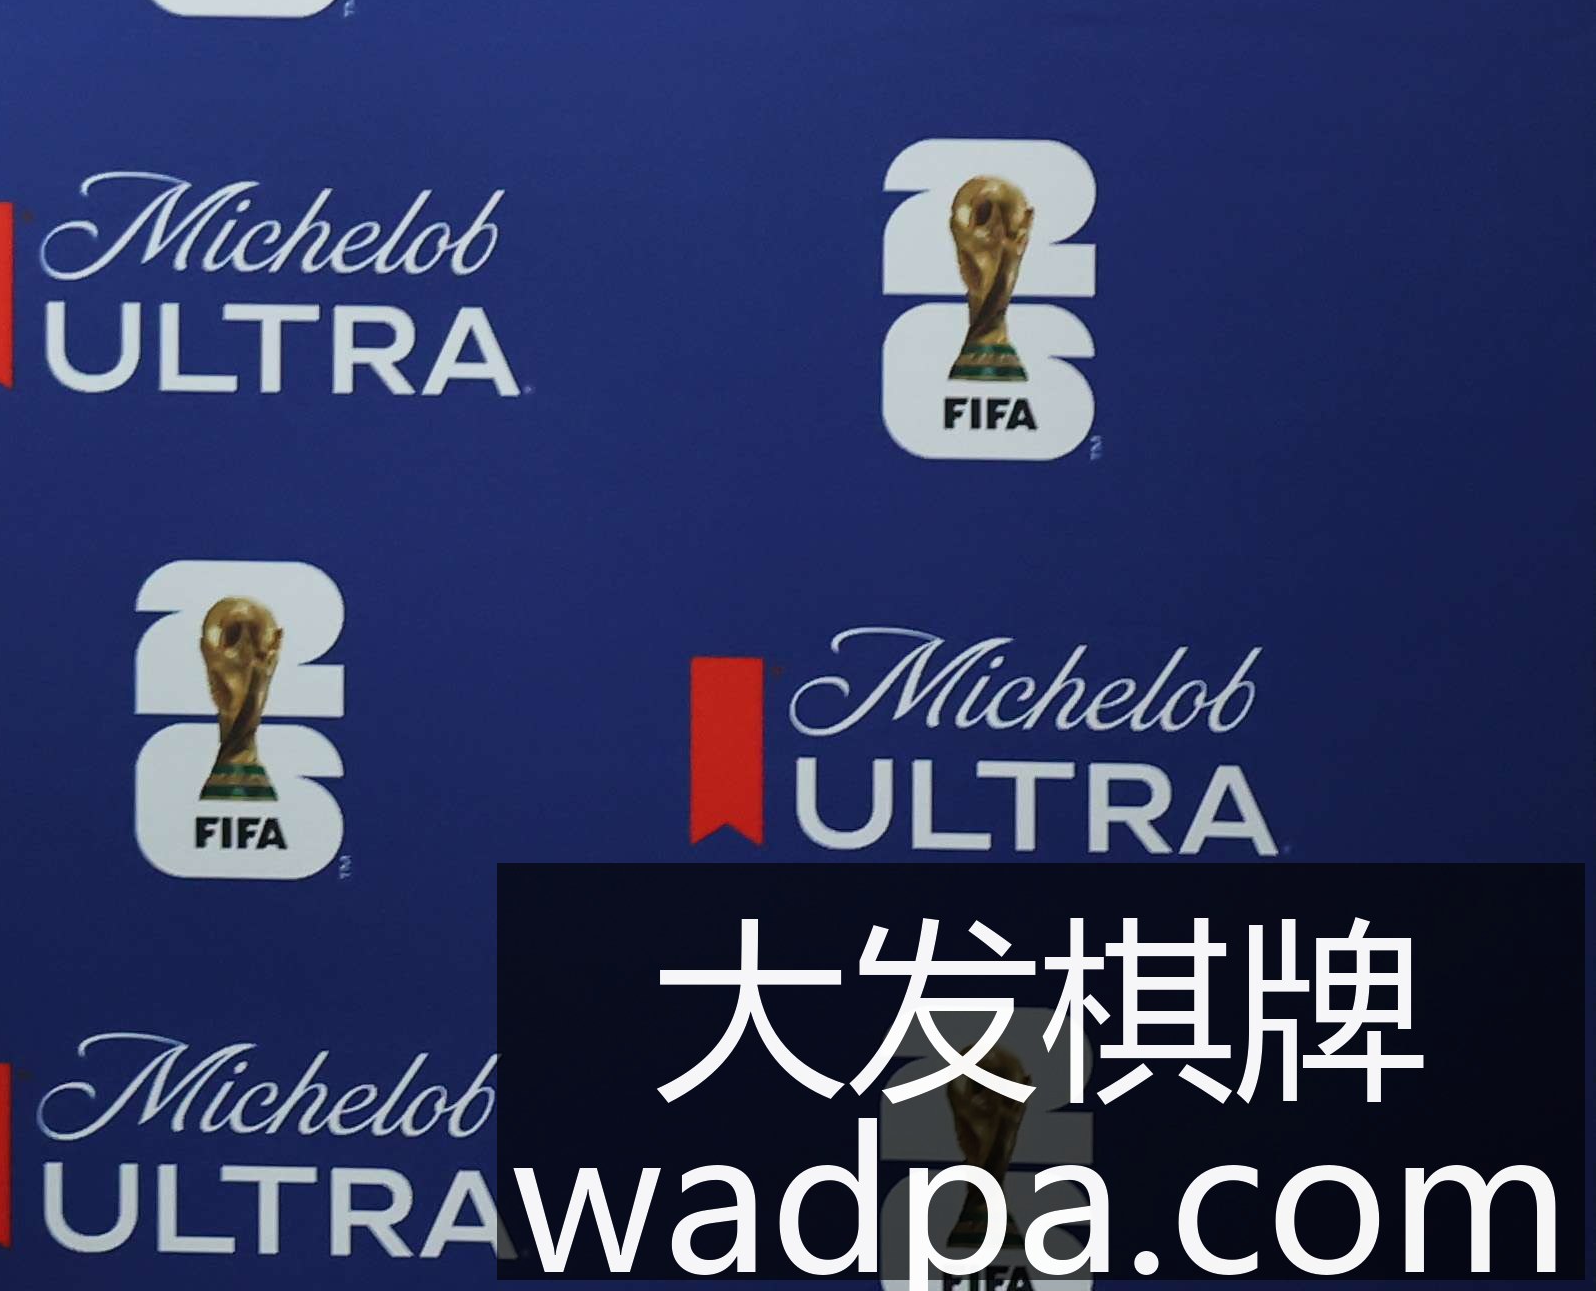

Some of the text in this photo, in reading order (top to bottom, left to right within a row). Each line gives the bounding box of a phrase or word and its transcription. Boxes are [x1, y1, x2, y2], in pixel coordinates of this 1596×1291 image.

[45, 172, 504, 280] Michelob
[46, 301, 520, 396] ULTRA
[943, 397, 1039, 431] FIFA
[790, 627, 1262, 736] Michelob
[194, 816, 288, 851] FIFA
[796, 757, 1278, 856] ULTRA
[40, 1033, 501, 1140] Michelob
[44, 1162, 518, 1258] ULTRA
